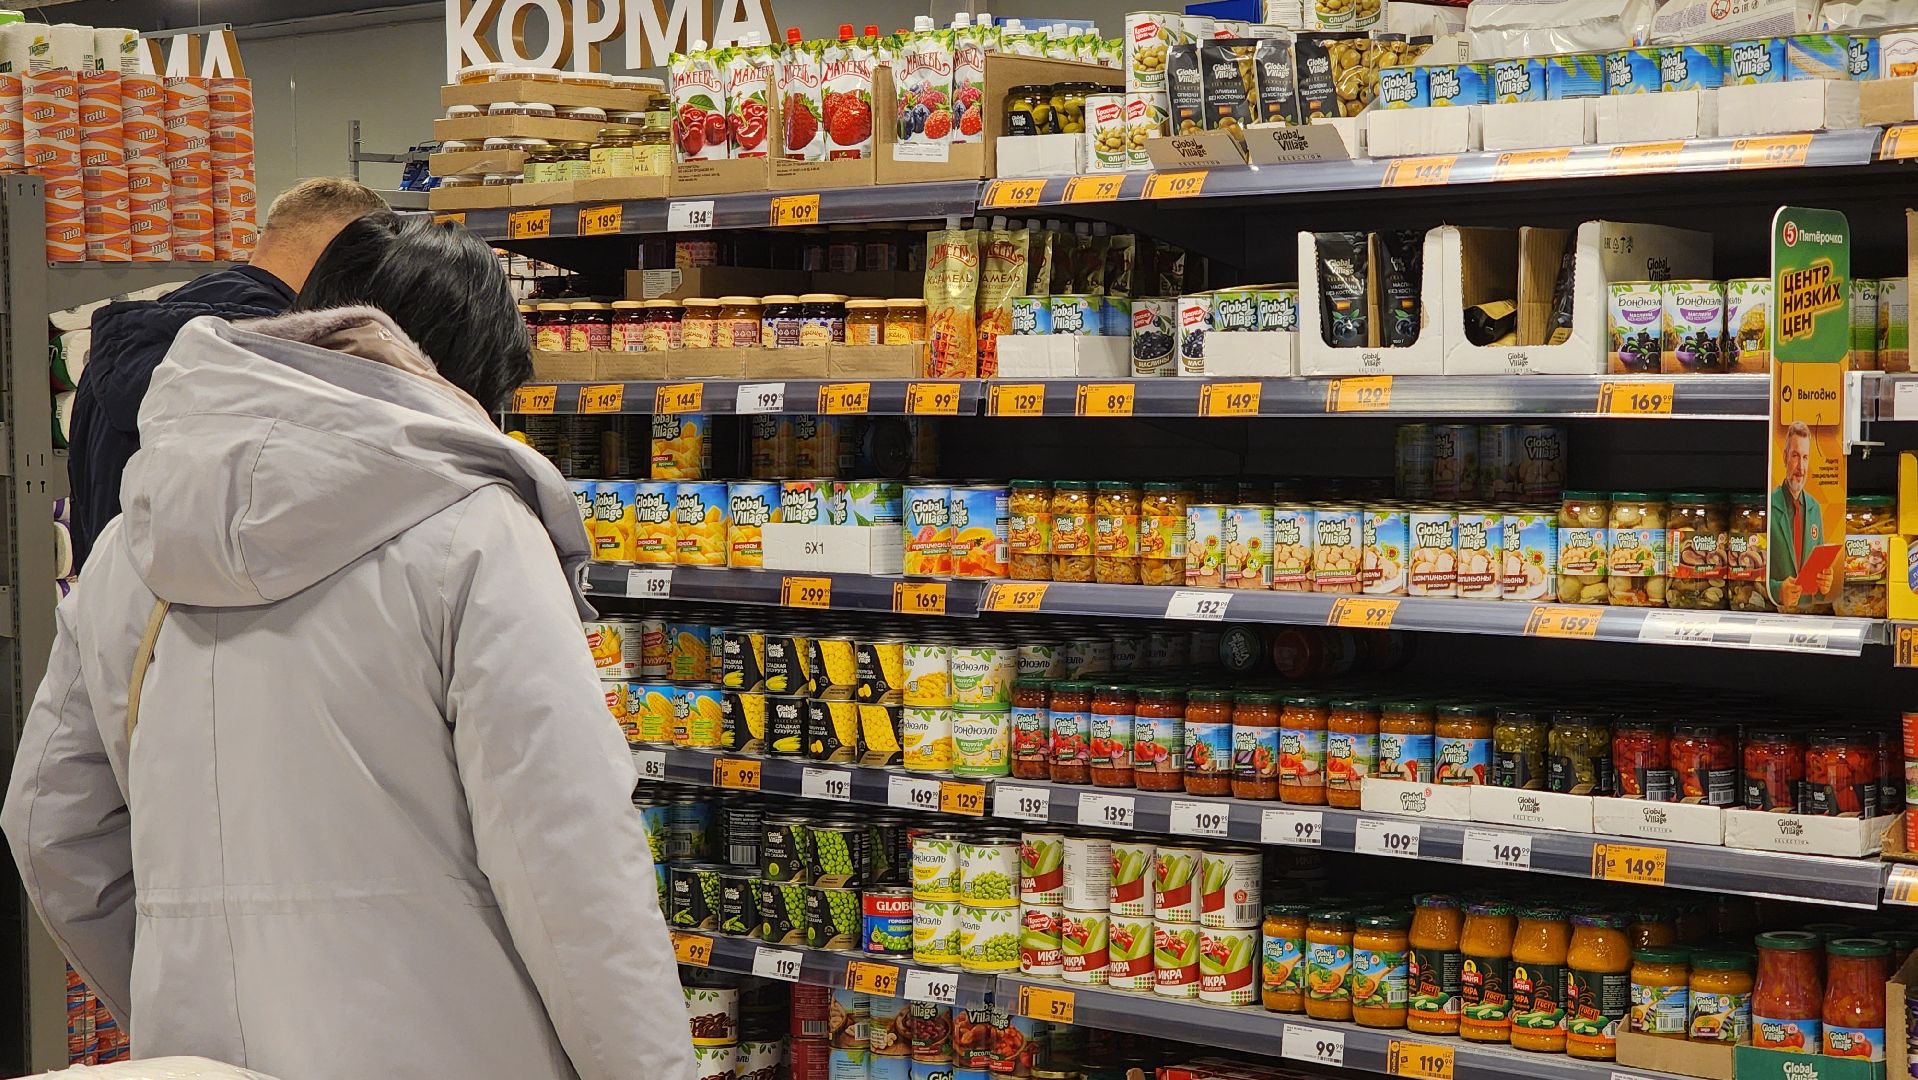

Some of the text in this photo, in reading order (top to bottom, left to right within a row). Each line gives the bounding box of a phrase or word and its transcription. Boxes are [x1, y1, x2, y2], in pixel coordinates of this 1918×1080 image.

[446, 0, 776, 86] КОРМА
[84, 110, 106, 122] tolli
[1273, 129, 1304, 141] Global
[86, 152, 108, 165] tolli
[1096, 183, 1112, 196] 79
[1170, 178, 1196, 190] 109
[1010, 188, 1033, 200] 169
[689, 211, 706, 224] 134
[792, 206, 810, 218] 109
[527, 220, 543, 231] 164
[598, 215, 615, 227] 189
[1799, 230, 1842, 245] Пятёрочка
[1784, 265, 1830, 294] ЦЕНТР
[1784, 282, 1840, 314] НИЗКИХ
[1783, 312, 1812, 338] ЦЕН
[532, 395, 548, 407] 179
[598, 394, 615, 406] 149
[676, 393, 695, 406] 144
[757, 394, 777, 406] 199
[841, 394, 861, 406] 104
[935, 395, 950, 407] 99
[1226, 394, 1250, 408] 149
[1357, 388, 1382, 403] 129
[1797, 388, 1837, 402] Выгодно
[1014, 395, 1036, 409] 129
[1108, 395, 1124, 409] 89
[1630, 394, 1662, 410] 169
[805, 542, 824, 554] 6X1
[646, 579, 664, 592] 159
[801, 588, 824, 601] 299
[915, 593, 938, 608] 169
[1013, 591, 1036, 604] 159
[1197, 600, 1221, 613] 132
[1366, 608, 1387, 621] 99
[1560, 616, 1590, 630] 159
[646, 761, 659, 773] 85
[739, 770, 753, 783] 99
[826, 780, 843, 794] 119
[910, 789, 931, 802] 169
[957, 794, 977, 808] 129
[1020, 798, 1041, 812] 139
[1104, 806, 1127, 820] 139
[1196, 814, 1220, 828] 109
[1295, 823, 1313, 837] 99
[1383, 832, 1410, 849] 109
[1493, 845, 1520, 861] 149
[1626, 858, 1655, 875] 149
[690, 945, 704, 958] 99
[1038, 950, 1062, 962] ИКРА
[777, 960, 795, 974] 119
[1158, 969, 1183, 980] ИКРА
[1203, 975, 1227, 986] ИКРА
[874, 975, 890, 989] 89
[928, 982, 949, 997] 169
[1050, 1000, 1066, 1015] 57
[1316, 1041, 1335, 1056] 99
[1420, 1055, 1444, 1072] 119
[1783, 1062, 1813, 1076] Global
